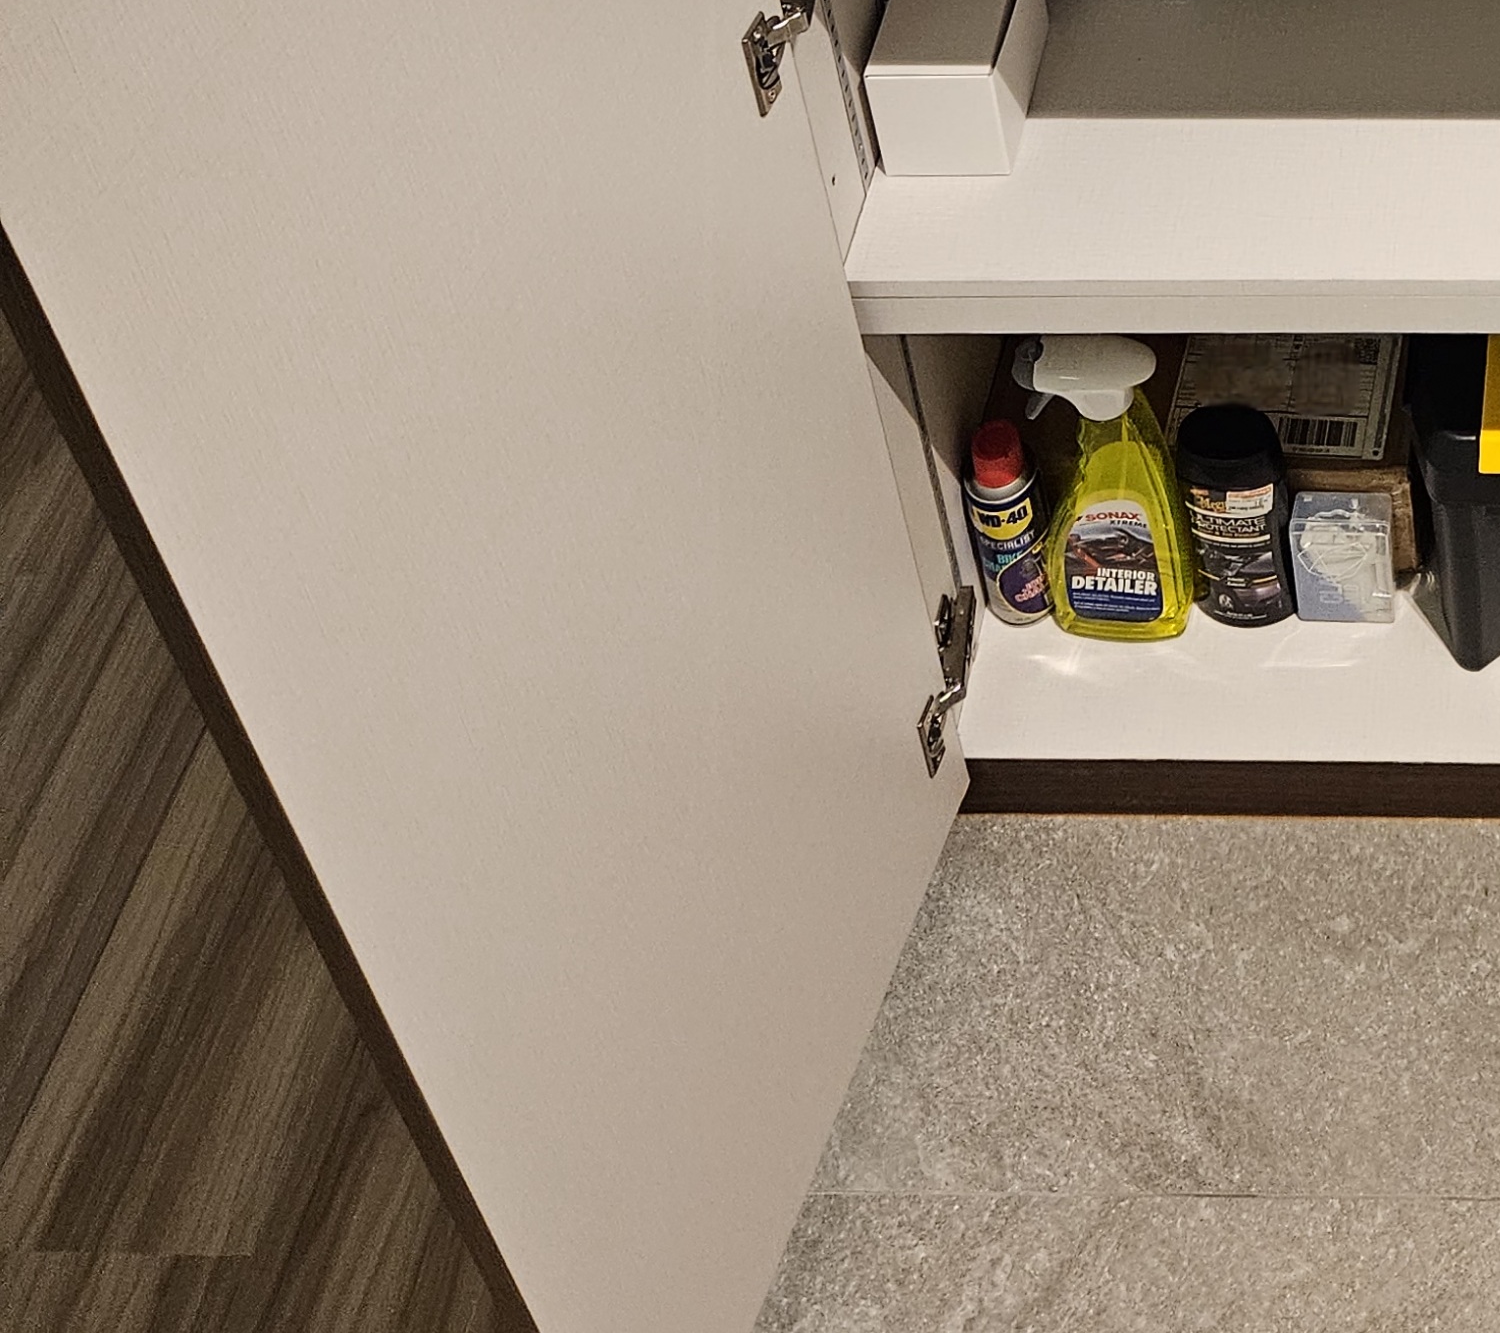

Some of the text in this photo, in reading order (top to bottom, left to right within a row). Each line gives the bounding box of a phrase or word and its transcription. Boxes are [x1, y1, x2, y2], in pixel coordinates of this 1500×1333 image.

[976, 505, 1028, 527] WD-40
[1085, 512, 1141, 521] SONAX
[1110, 520, 1147, 528] XTREME
[980, 529, 1036, 550] SPECIALIST
[1097, 568, 1155, 581] INTERIOR
[1071, 576, 1158, 595] DETAILER
